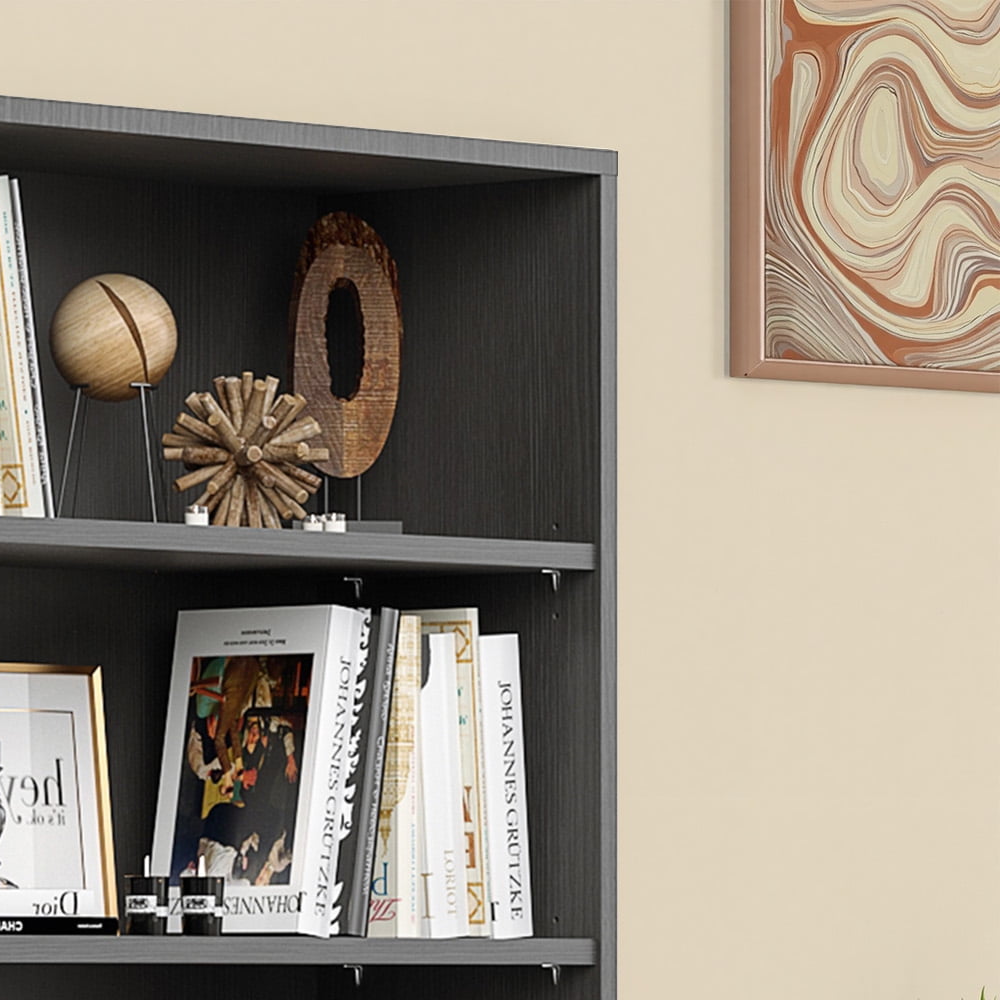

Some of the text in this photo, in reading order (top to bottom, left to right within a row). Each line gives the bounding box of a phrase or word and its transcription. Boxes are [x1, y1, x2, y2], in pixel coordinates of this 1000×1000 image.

[328, 656, 351, 790] JOHANNES
[498, 680, 518, 804] JOHANNES
[223, 892, 308, 916] JOHANNES
[443, 849, 457, 915] LORIOT
